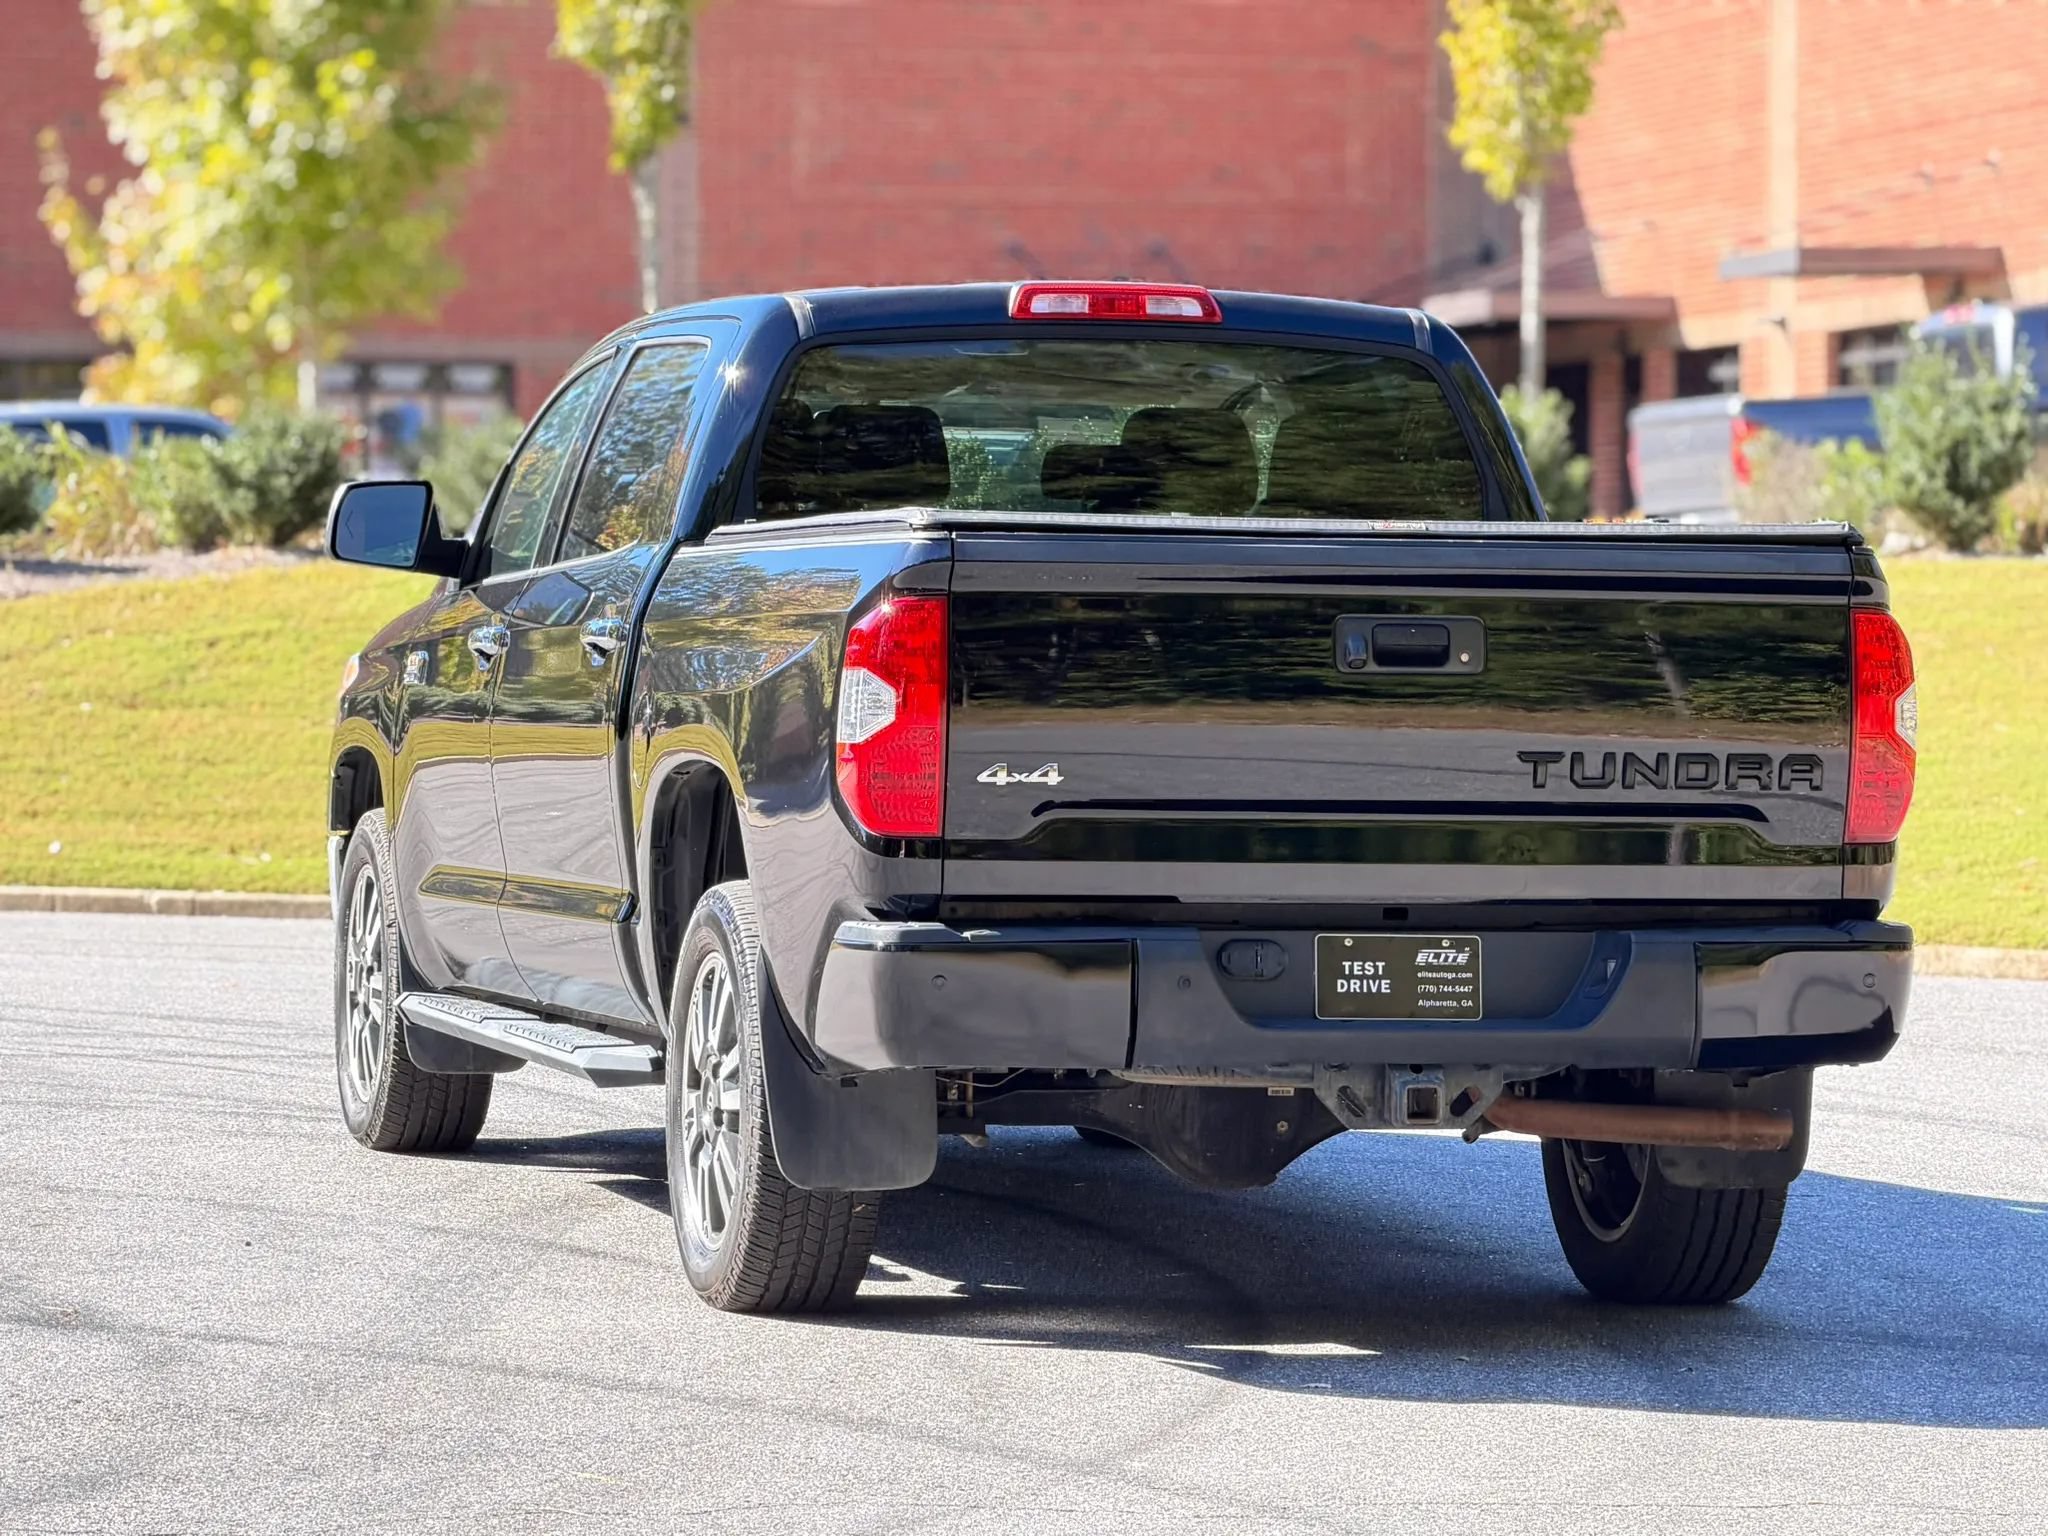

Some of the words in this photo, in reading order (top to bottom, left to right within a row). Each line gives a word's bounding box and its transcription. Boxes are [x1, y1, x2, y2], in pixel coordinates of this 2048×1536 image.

[976, 763, 1065, 785] 4x4
[1517, 750, 1824, 790] TUNDRA
[1416, 952, 1470, 963] ELITE
[1342, 961, 1386, 975] TEST
[1417, 971, 1473, 979] eliteautoga.com
[1336, 979, 1391, 993] DRIVE
[1417, 984, 1437, 994] (770)
[1439, 985, 1473, 993] 744-5447
[1417, 999, 1460, 1008] Alpharetta,
[1461, 999, 1473, 1007] GA
